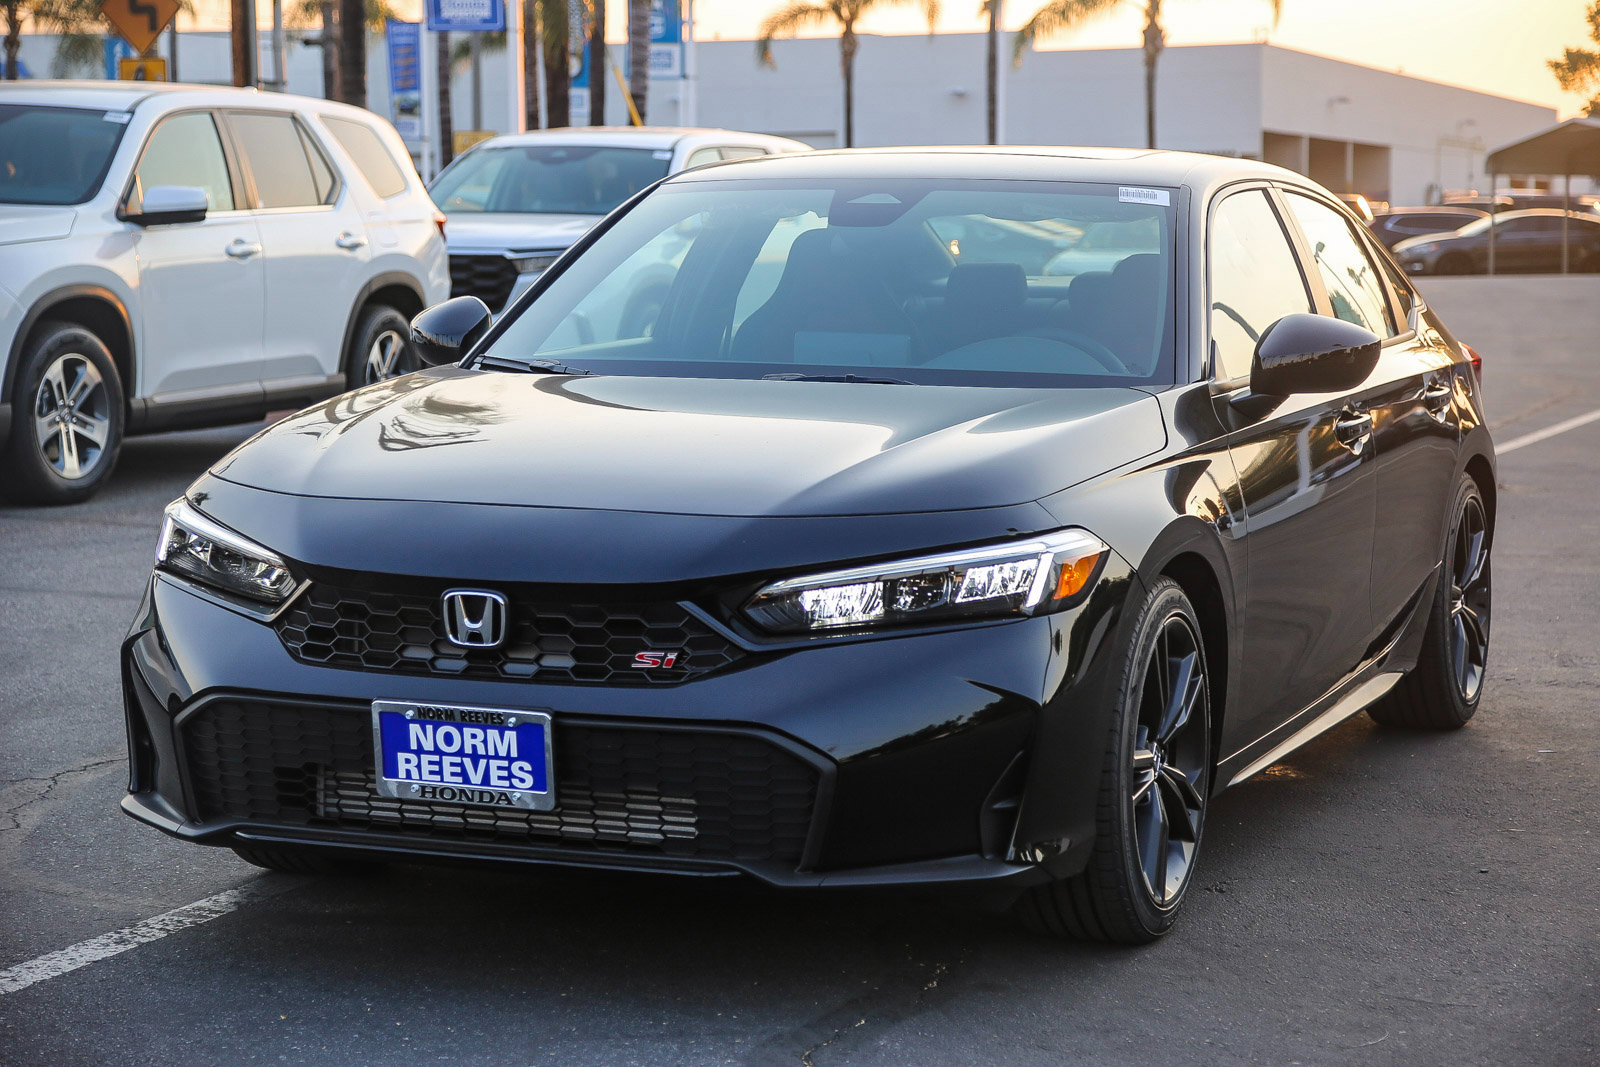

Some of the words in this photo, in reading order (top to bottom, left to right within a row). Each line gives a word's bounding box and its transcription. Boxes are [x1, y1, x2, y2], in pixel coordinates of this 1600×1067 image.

[631, 652, 678, 668] Si
[417, 707, 455, 721] NORM
[460, 710, 504, 725] REEVES
[409, 723, 518, 758] NORM
[397, 752, 533, 789] REEVES
[419, 786, 514, 806] HONDA
